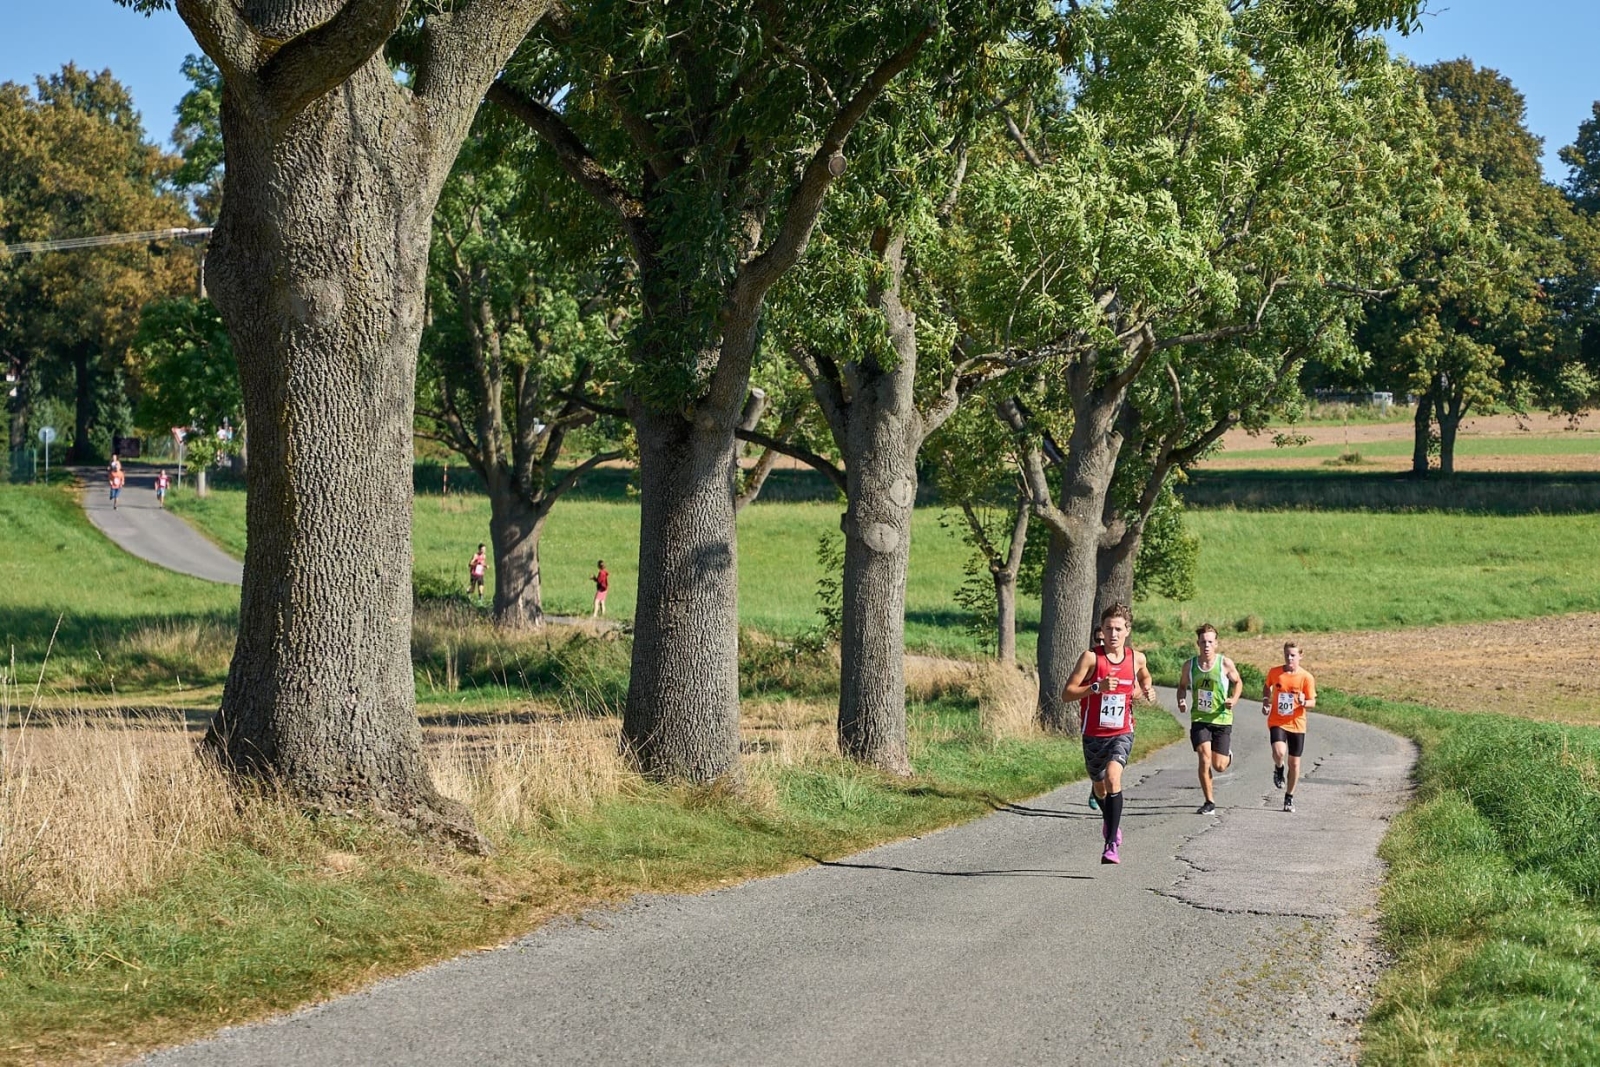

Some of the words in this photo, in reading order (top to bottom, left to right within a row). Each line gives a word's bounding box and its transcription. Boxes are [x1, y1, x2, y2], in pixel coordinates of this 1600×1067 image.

[1198, 698, 1212, 708] 212
[1278, 702, 1292, 710] 201
[1101, 705, 1124, 716] 417
